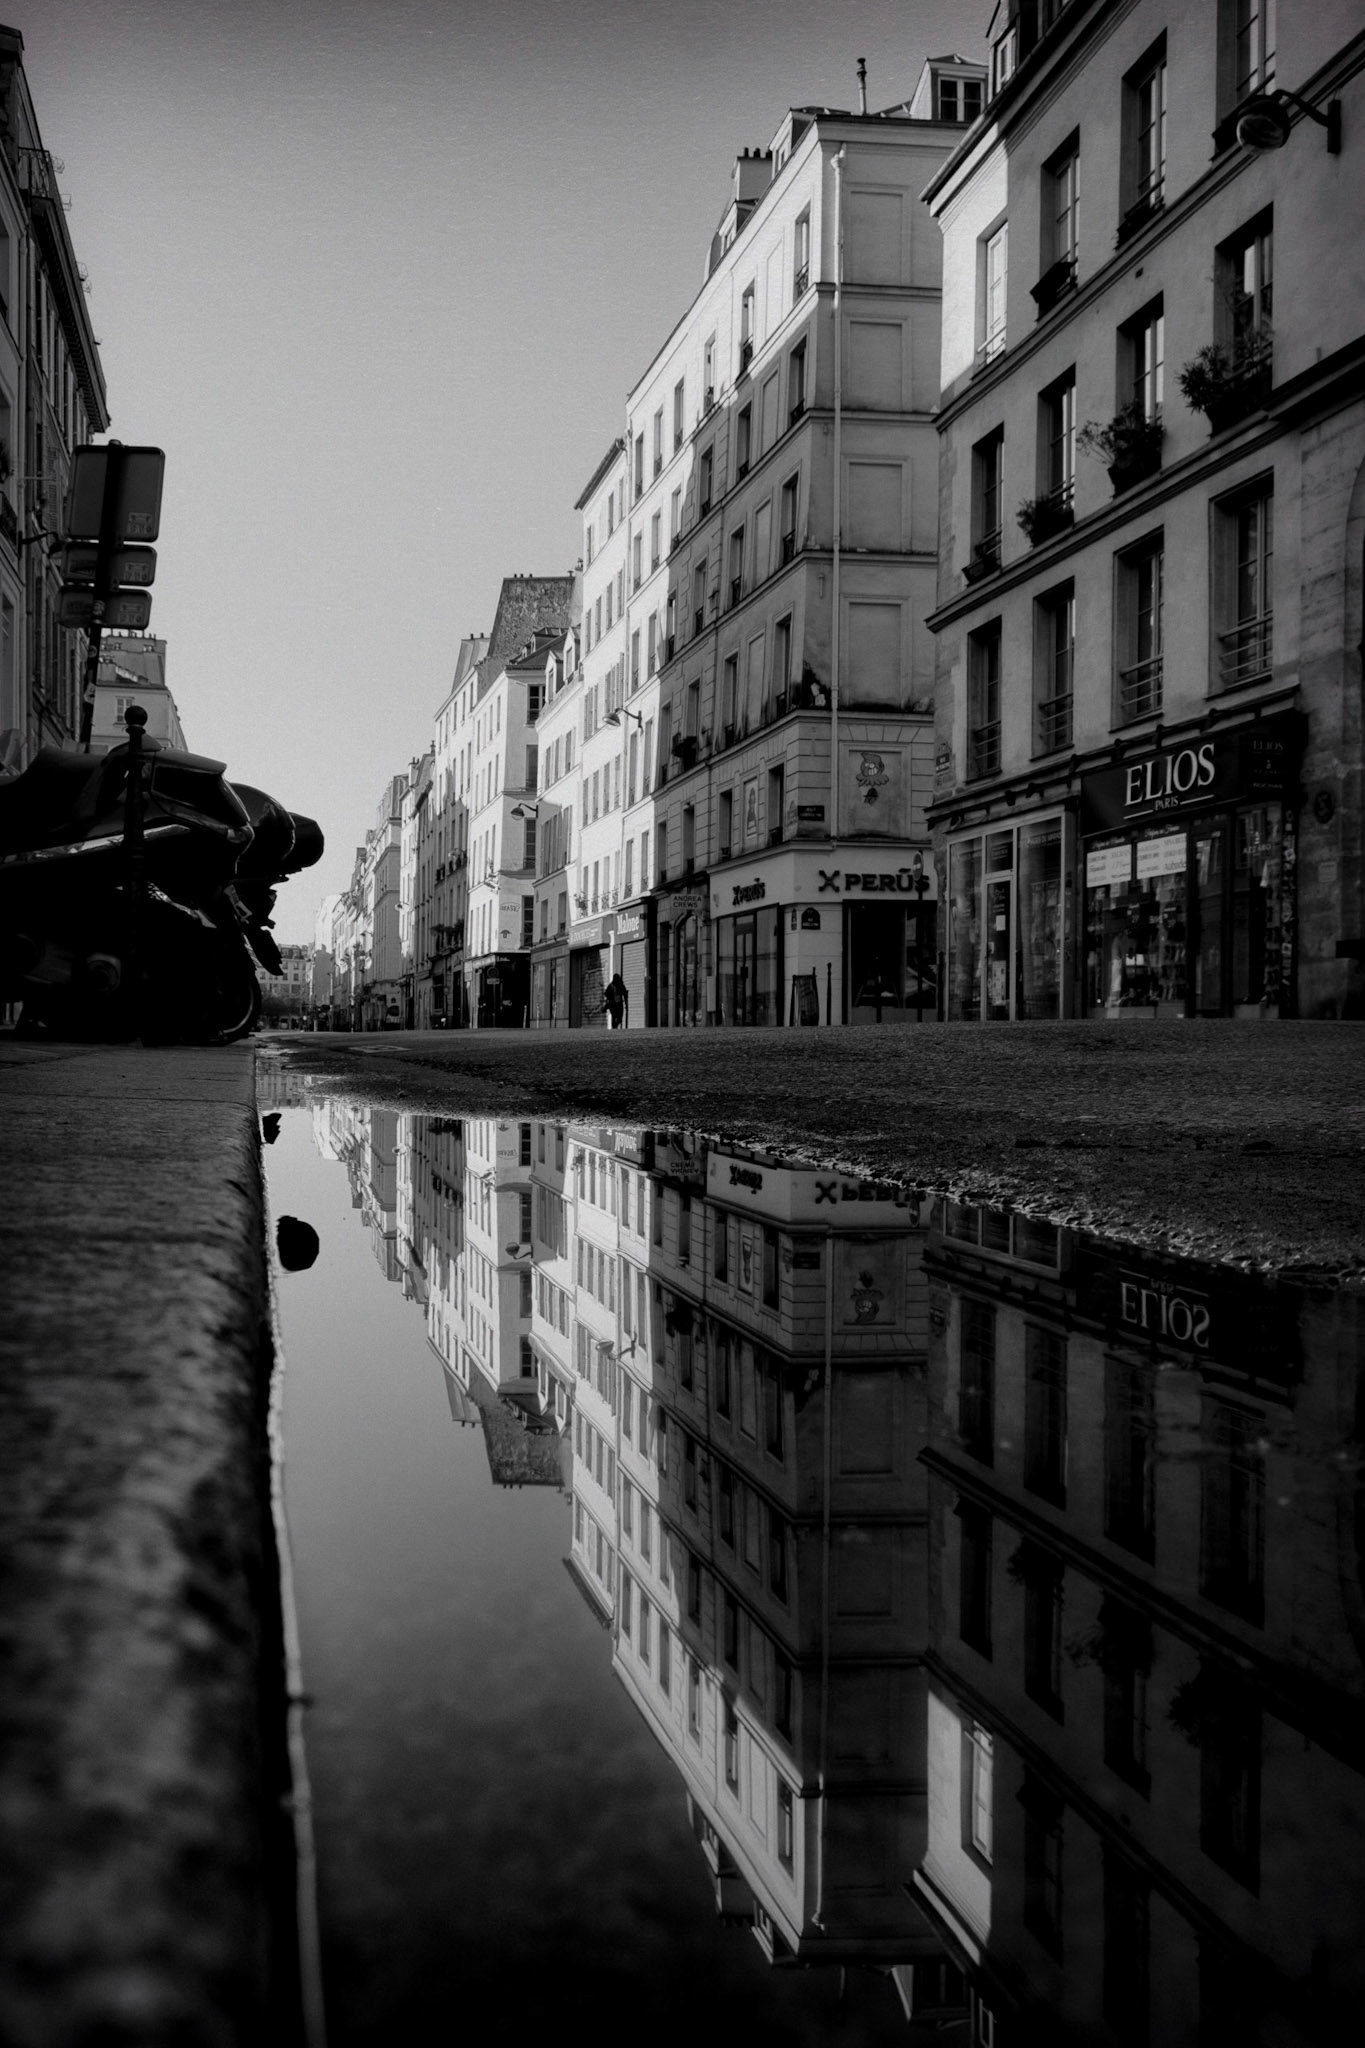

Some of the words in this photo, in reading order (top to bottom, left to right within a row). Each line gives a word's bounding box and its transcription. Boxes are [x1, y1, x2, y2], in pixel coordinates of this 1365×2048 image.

[1123, 742, 1216, 806] ELIOS
[1154, 795, 1180, 812] PARIS
[616, 913, 640, 935] Malone
